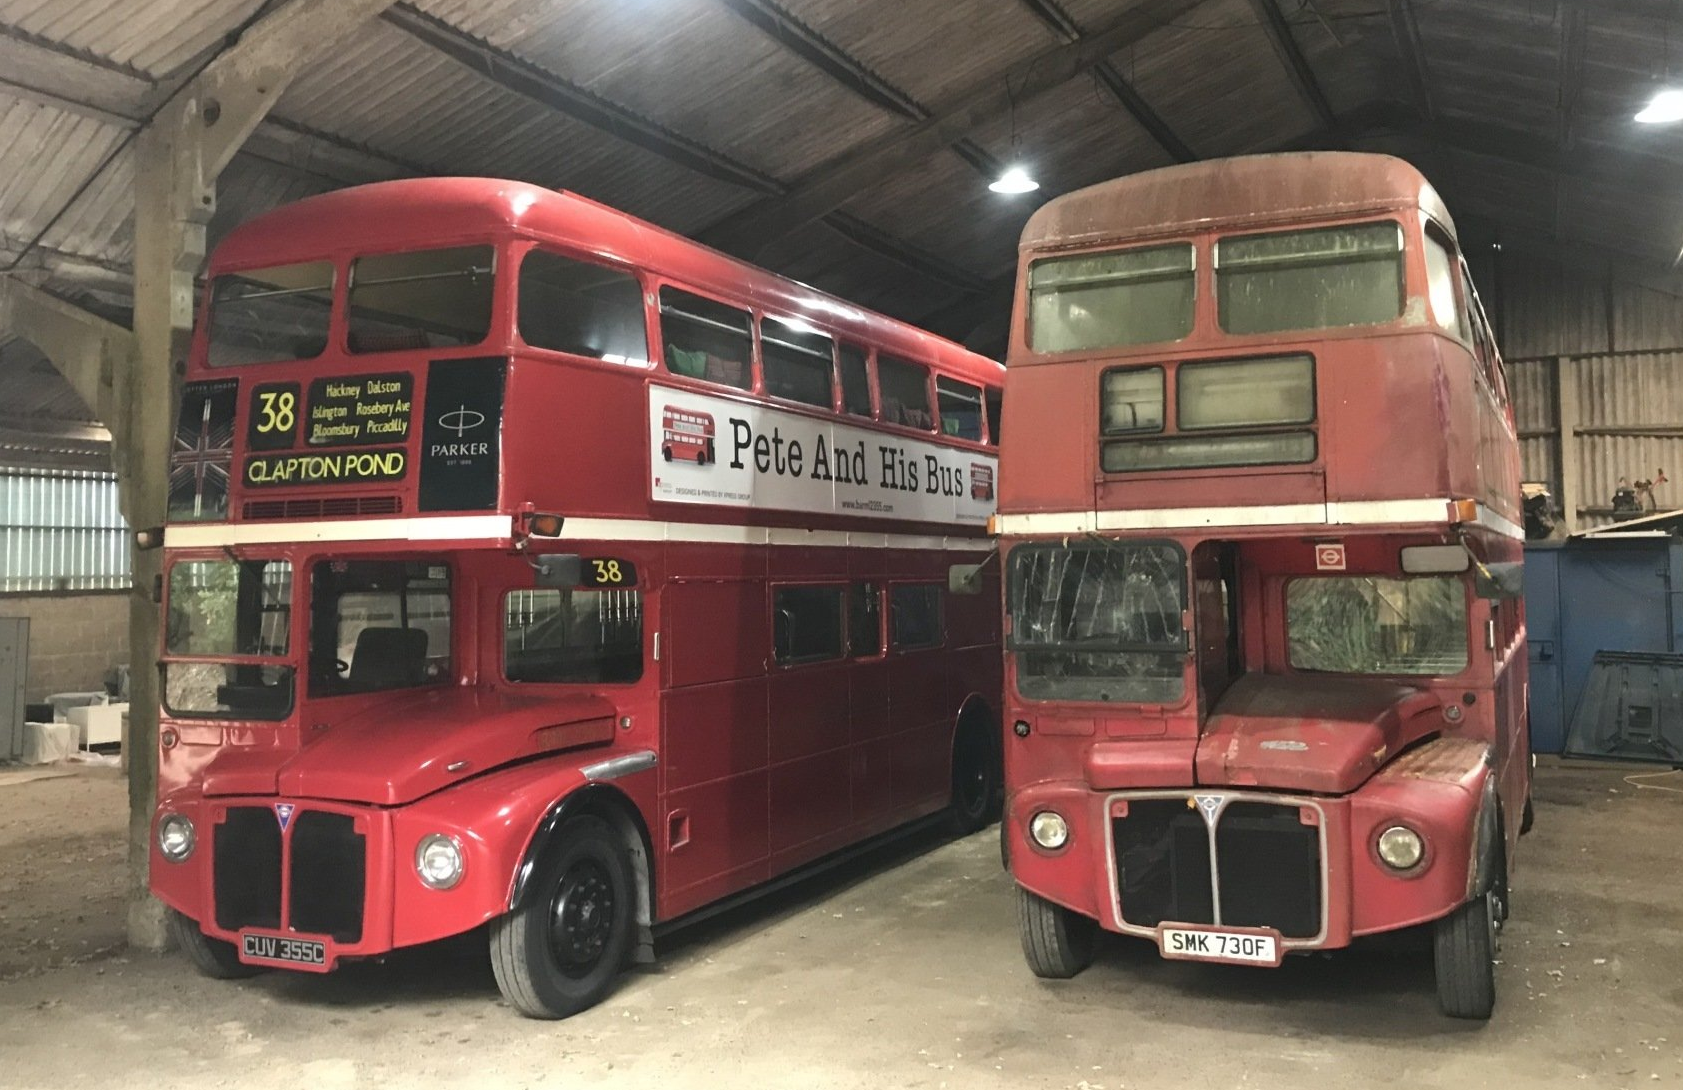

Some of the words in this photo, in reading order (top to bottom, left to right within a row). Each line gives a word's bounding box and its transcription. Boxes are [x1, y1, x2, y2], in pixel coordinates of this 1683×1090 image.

[326, 384, 361, 399] Hackney
[367, 381, 401, 394] Dalston
[257, 392, 295, 433] 38
[312, 405, 348, 421] Islington
[356, 401, 394, 417] Rosebery
[395, 399, 411, 412] Ave
[312, 423, 360, 438] Bloomsbury
[366, 419, 408, 435] Piccadilly
[431, 442, 488, 457] PARKER
[729, 417, 803, 478] Pete
[810, 433, 869, 486] And
[879, 445, 919, 493] His
[925, 454, 964, 498] Bus
[248, 455, 342, 482] CLAPTON
[344, 452, 404, 477] POND
[592, 560, 622, 583] 38
[244, 936, 276, 957] CUV
[280, 940, 324, 963] 355C
[1172, 932, 1210, 953] SMK
[1216, 935, 1266, 957] 730F
